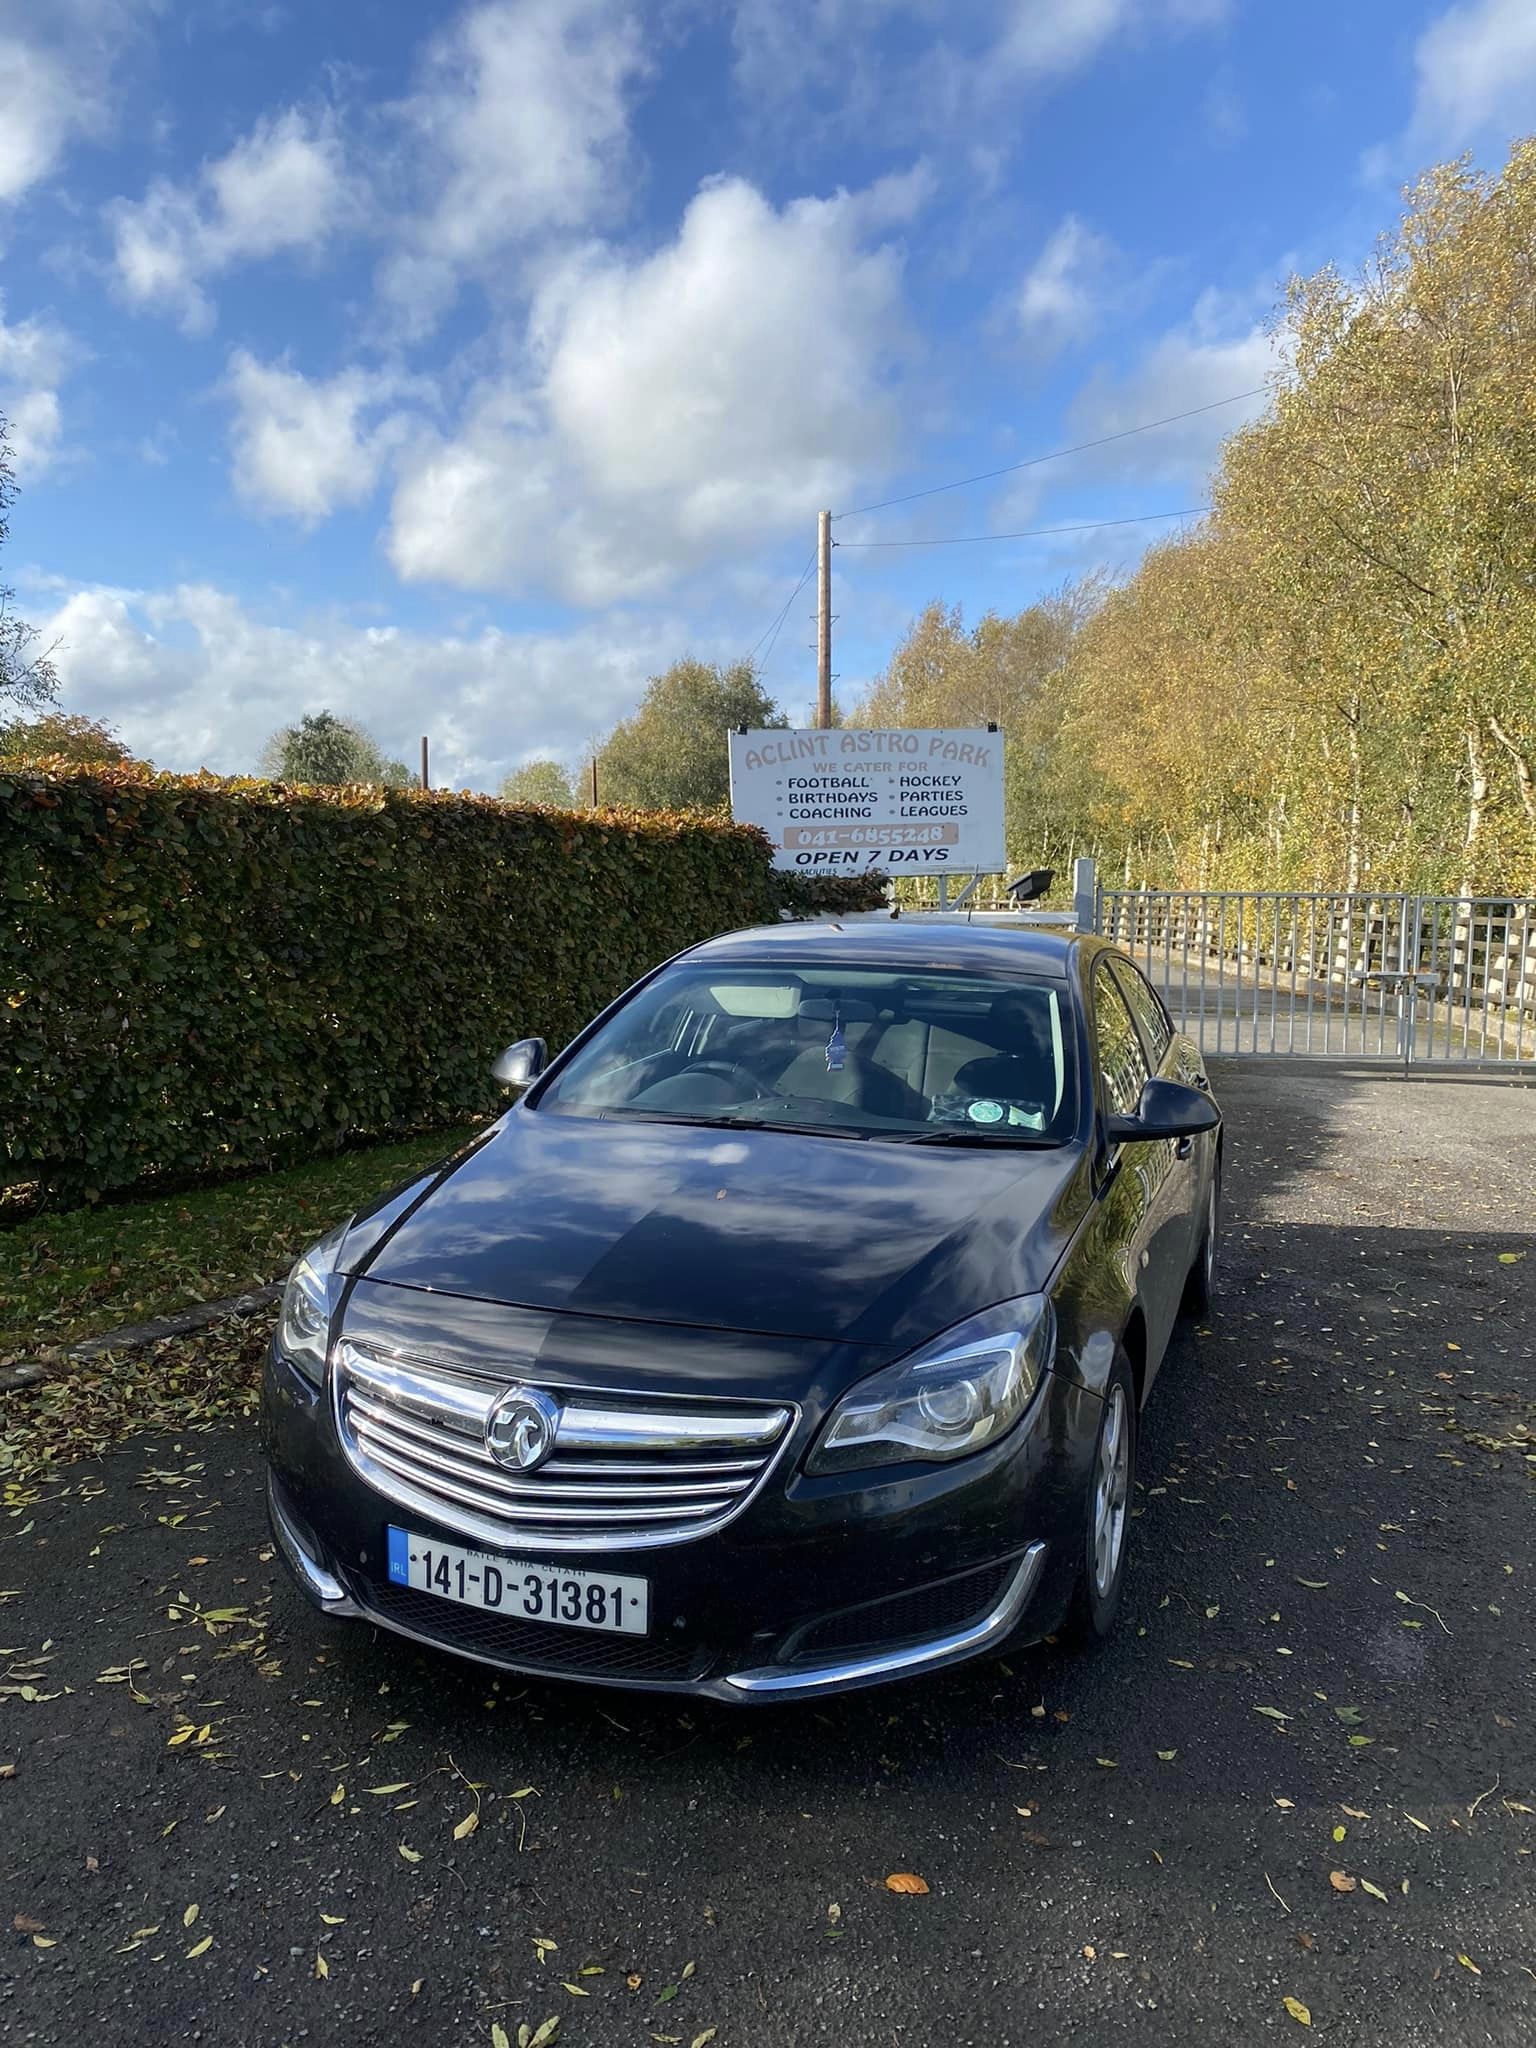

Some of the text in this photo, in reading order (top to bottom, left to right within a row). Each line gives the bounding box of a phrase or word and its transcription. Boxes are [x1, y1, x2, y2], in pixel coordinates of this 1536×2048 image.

[745, 733, 991, 770] ACLINT ASTRO PARK
[813, 761, 928, 773] WE CATER FOR
[788, 777, 870, 789] FOOTBALL
[900, 775, 962, 787] HOCKEY
[788, 792, 879, 804] BIRTHDAYS
[900, 790, 964, 802] PARTIES
[789, 806, 872, 819] COACHING
[900, 804, 968, 817] LEAGUES
[795, 848, 949, 865] OPEN 7 DAYS
[390, 1560, 407, 1577] IRL
[422, 1550, 623, 1627] 141-D-31381
